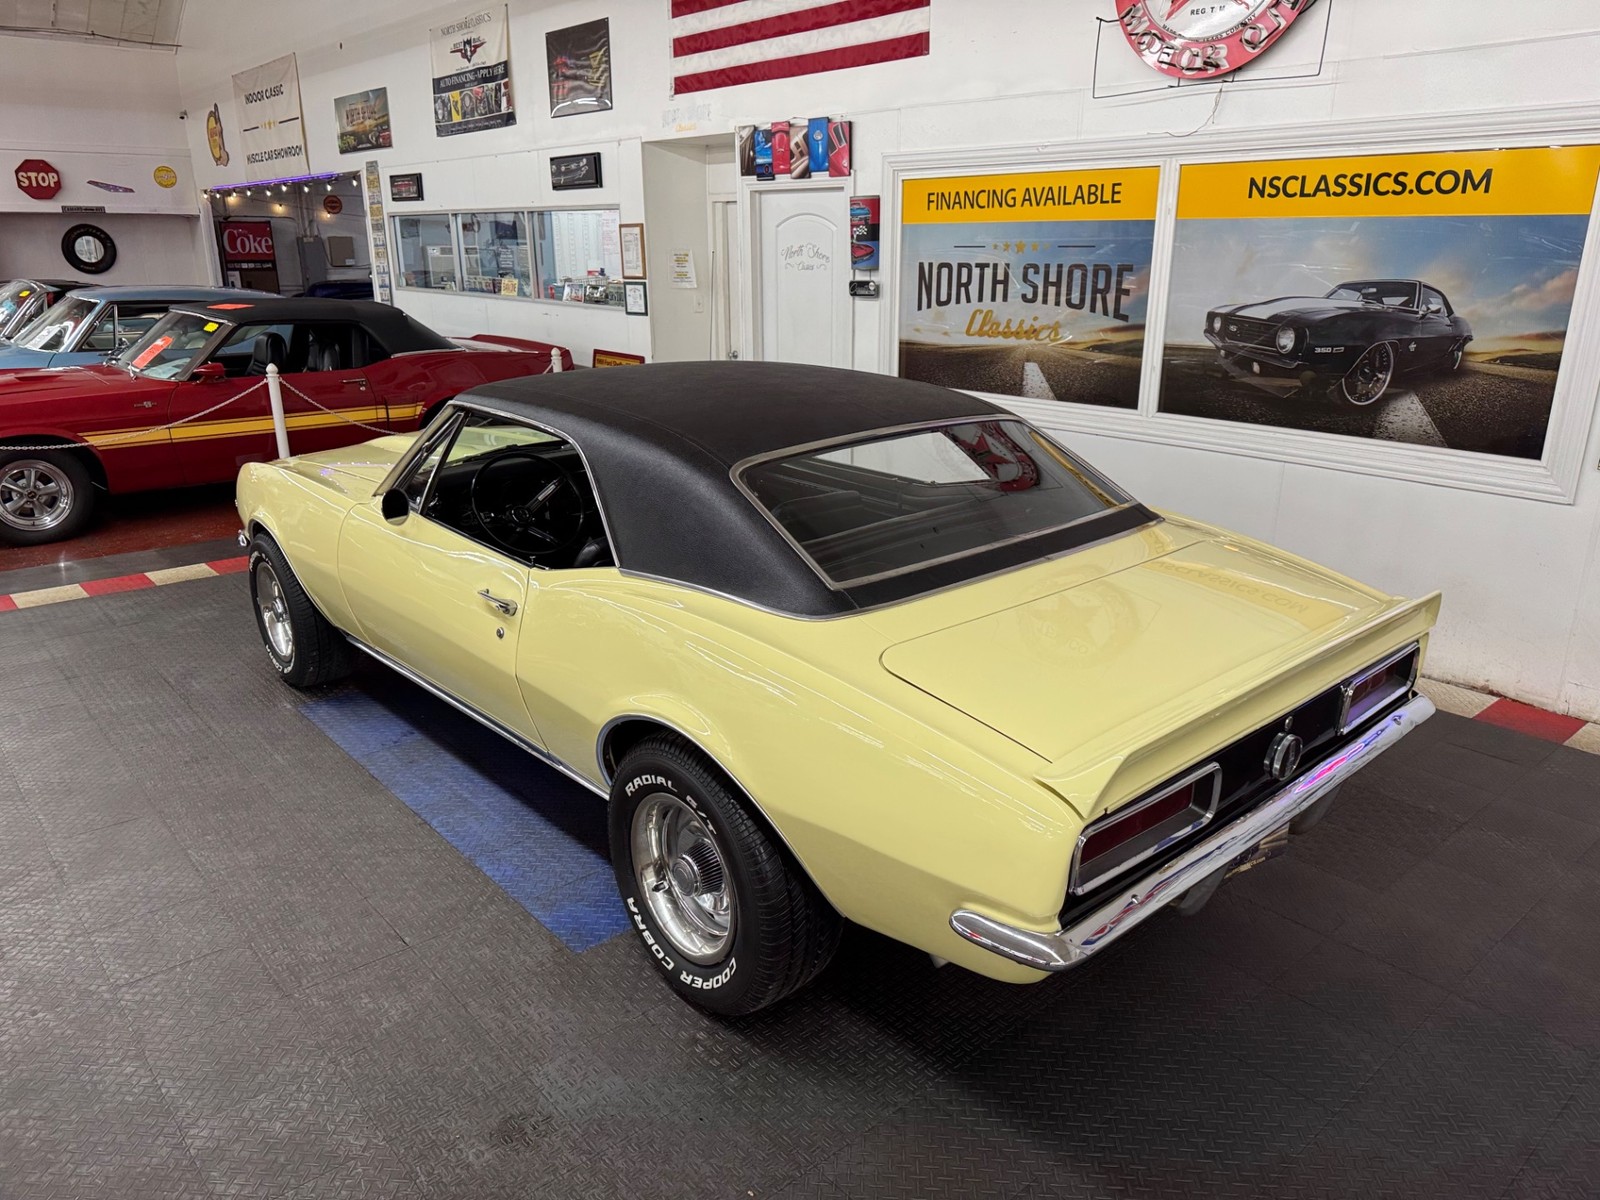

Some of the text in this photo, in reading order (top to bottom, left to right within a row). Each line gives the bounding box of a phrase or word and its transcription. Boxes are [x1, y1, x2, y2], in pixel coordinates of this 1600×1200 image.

[1190, 7, 1206, 16] REG
[1121, 4, 1229, 75] MOTOR
[244, 83, 284, 105] INDOOR CLASSIC
[264, 150, 274, 162] CAR
[273, 144, 303, 160] SHOWROOM
[17, 171, 59, 188] STOP
[1248, 168, 1493, 199] NSCLASSICS.COM
[927, 182, 1122, 211] FINANCING AVAILABLE
[225, 229, 273, 254] Coke
[781, 242, 831, 263] North Shore
[917, 262, 1134, 323] NORTH SHORE
[965, 309, 1063, 342] Classics
[625, 774, 678, 798] RADIAL
[626, 897, 737, 990] COOPER COBRA
